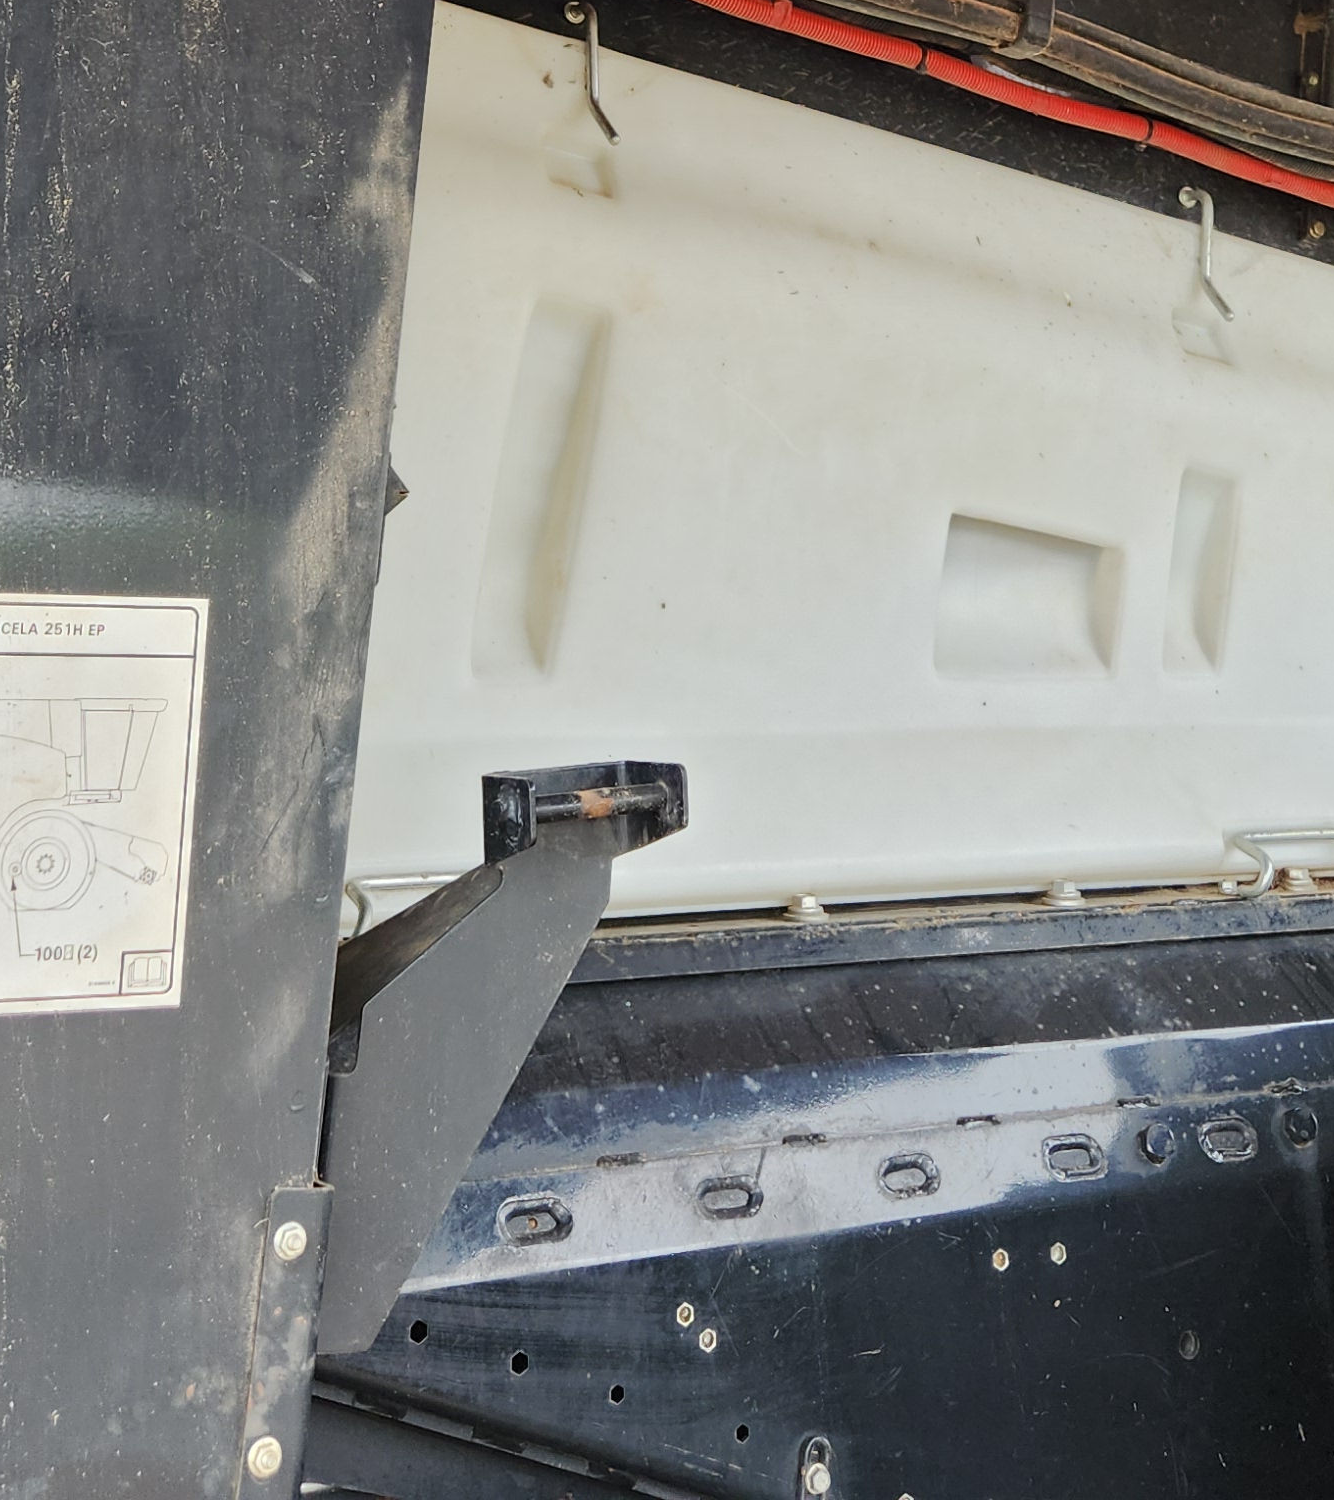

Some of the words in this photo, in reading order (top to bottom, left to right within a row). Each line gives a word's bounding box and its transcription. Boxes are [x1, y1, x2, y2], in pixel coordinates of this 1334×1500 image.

[44, 622, 83, 636] 251H
[88, 624, 105, 636] EP
[34, 945, 63, 962] 100
